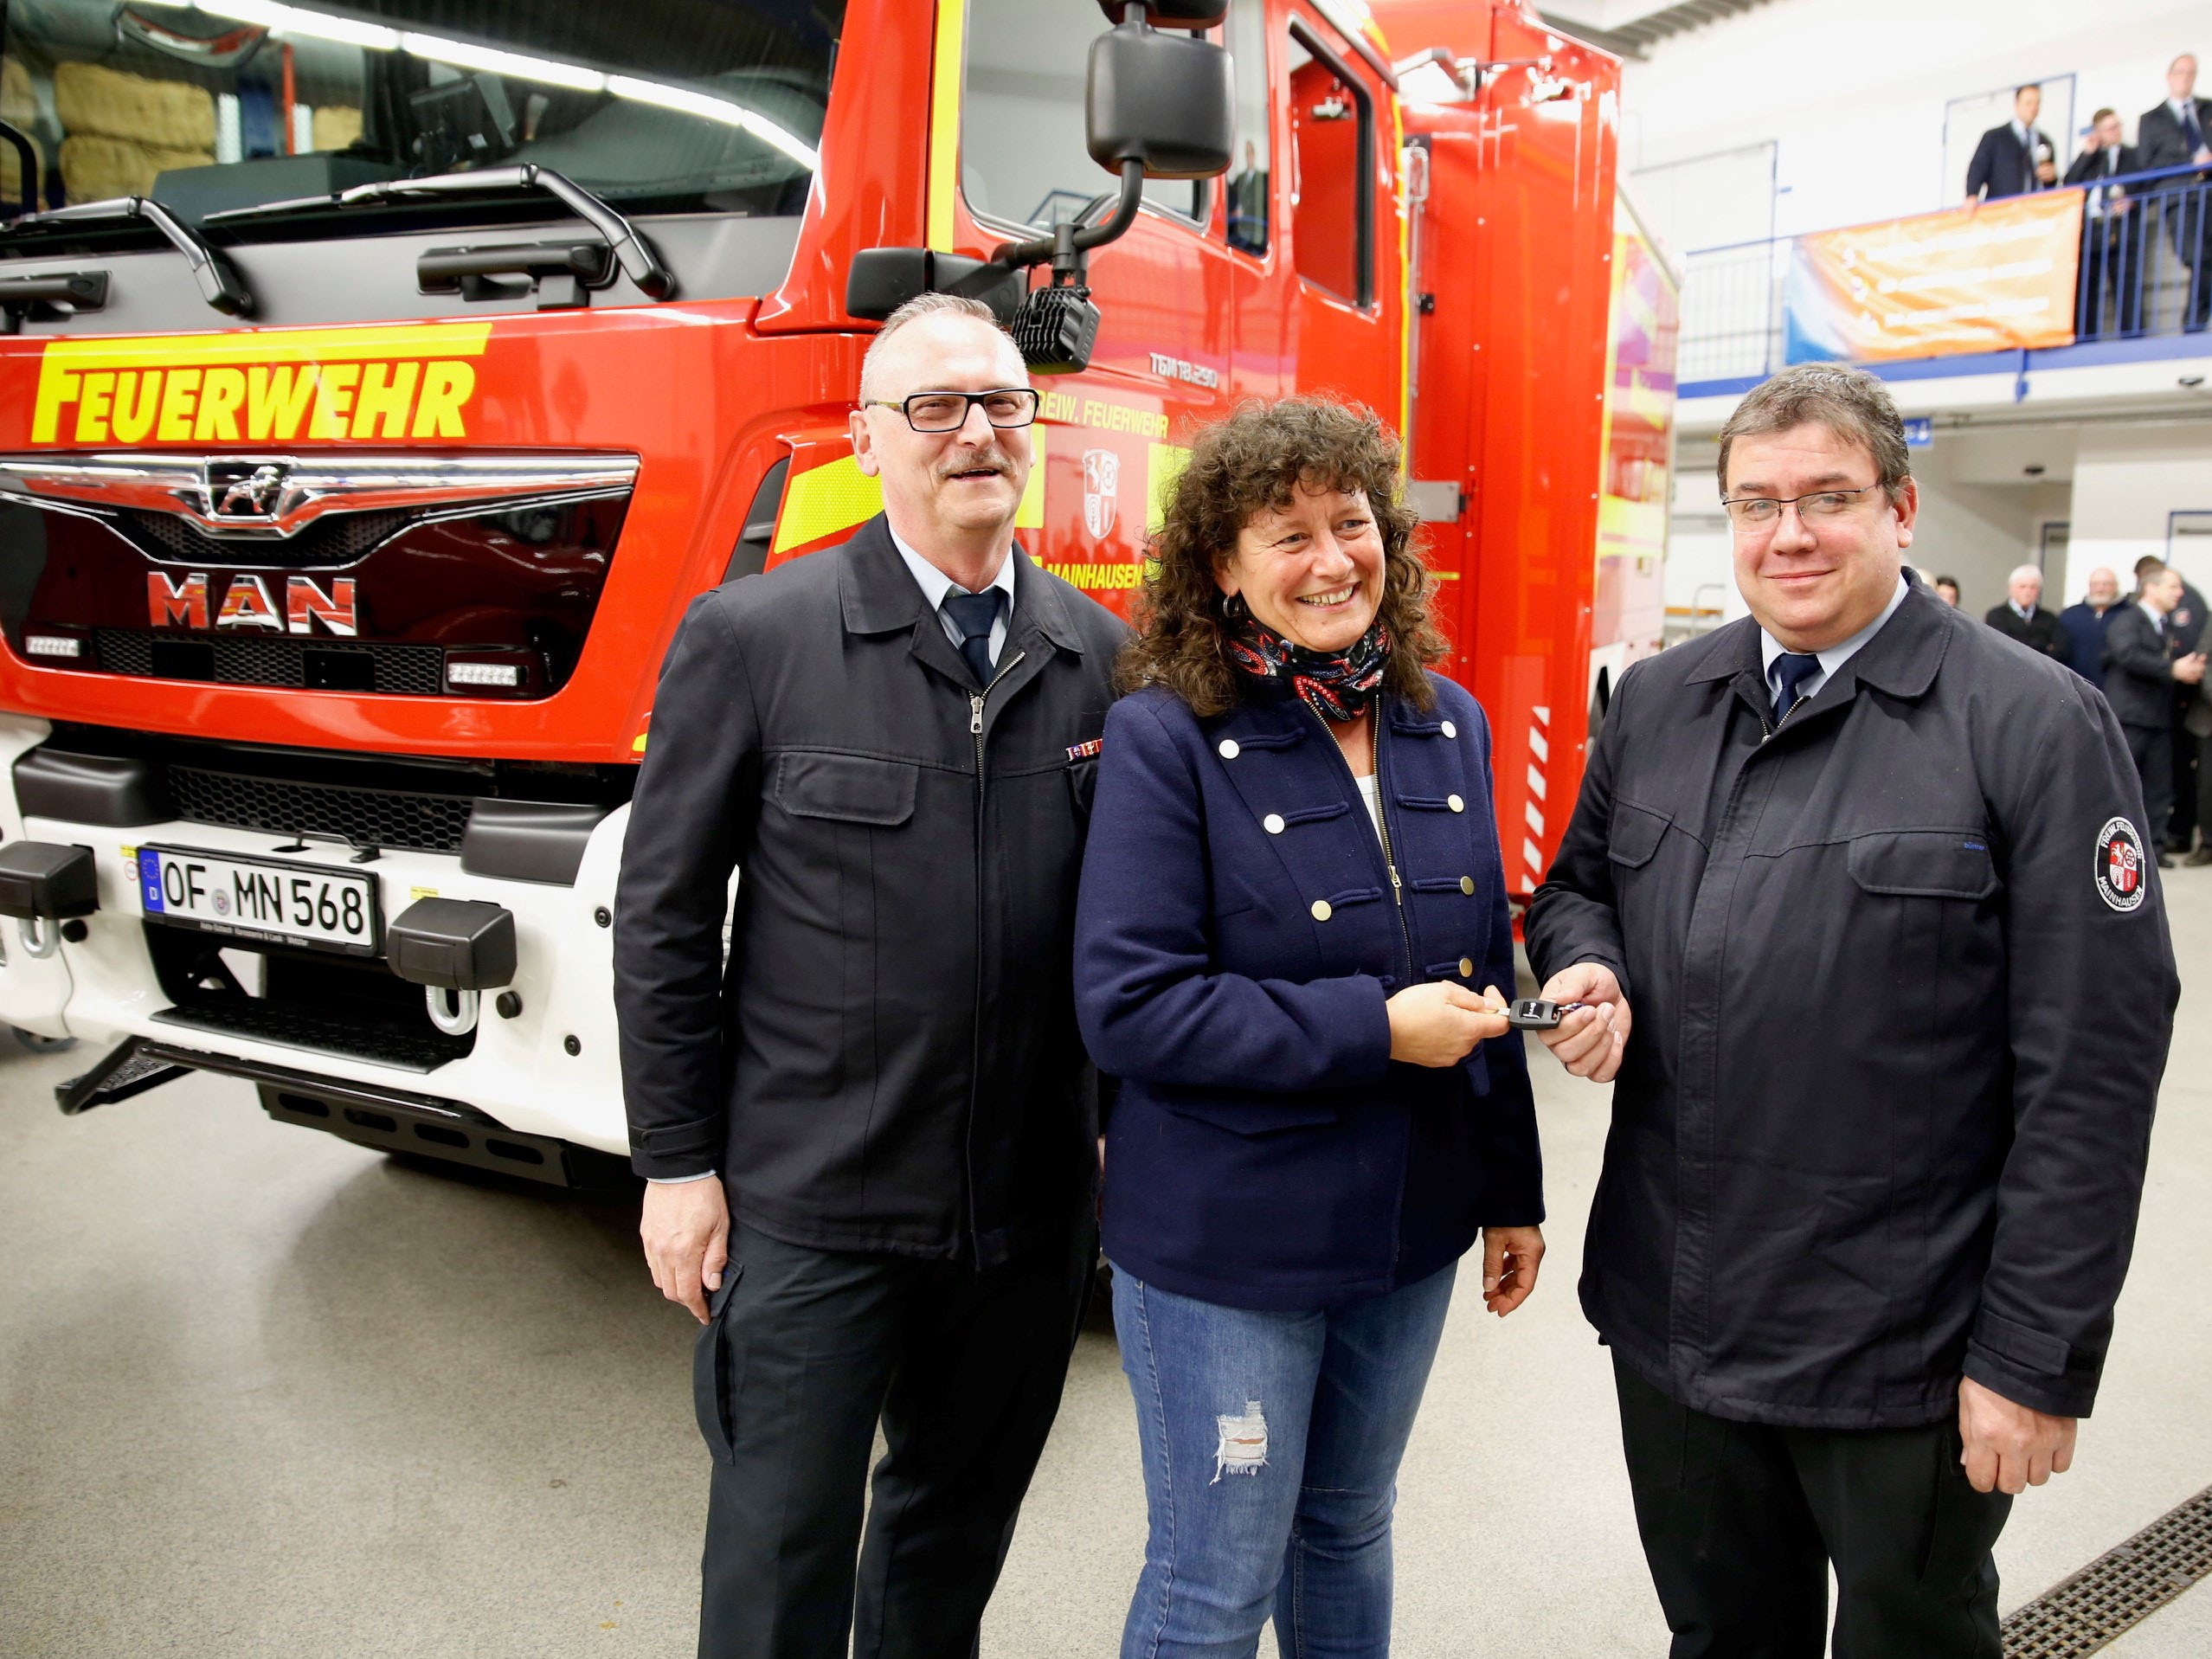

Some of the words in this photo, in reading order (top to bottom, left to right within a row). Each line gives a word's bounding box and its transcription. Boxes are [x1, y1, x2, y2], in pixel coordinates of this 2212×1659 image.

[31, 323, 492, 443] FEUERWEHR
[1037, 389, 1078, 423] REIW.
[1083, 399, 1168, 440] FEUERWEHR
[147, 571, 357, 636] MAN
[164, 862, 206, 909] OF
[233, 870, 283, 923] MN
[291, 879, 363, 935] 568
[2098, 876, 2144, 907] MAINHAUSEN
